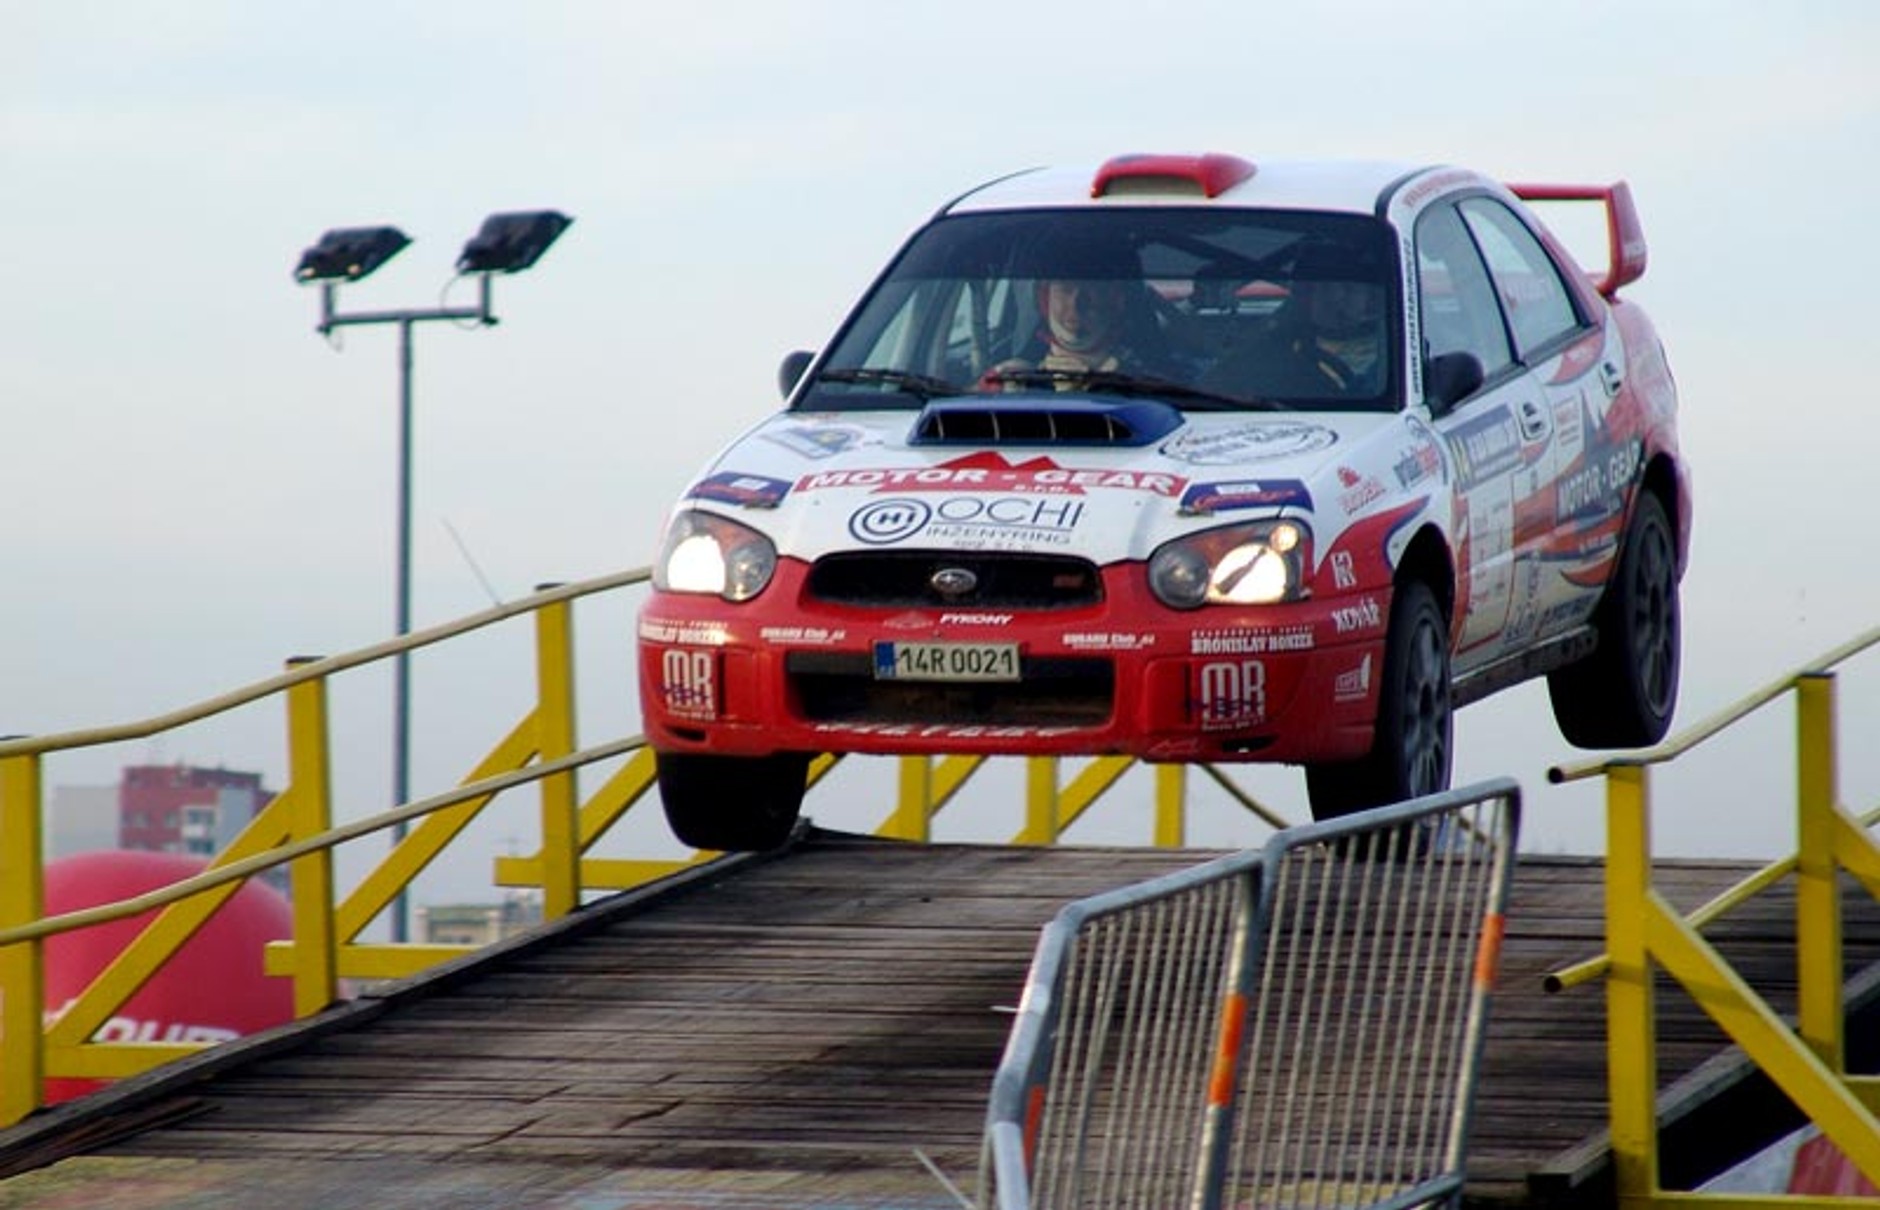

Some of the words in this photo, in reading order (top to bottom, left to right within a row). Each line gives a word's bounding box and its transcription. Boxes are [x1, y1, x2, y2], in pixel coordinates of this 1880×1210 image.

[806, 468, 990, 488] MOTOR
[1033, 469, 1175, 494] GEAR
[937, 497, 1085, 528] OCHI
[900, 648, 945, 673] 14R
[951, 648, 1014, 675] 0021
[1201, 660, 1267, 720] MR
